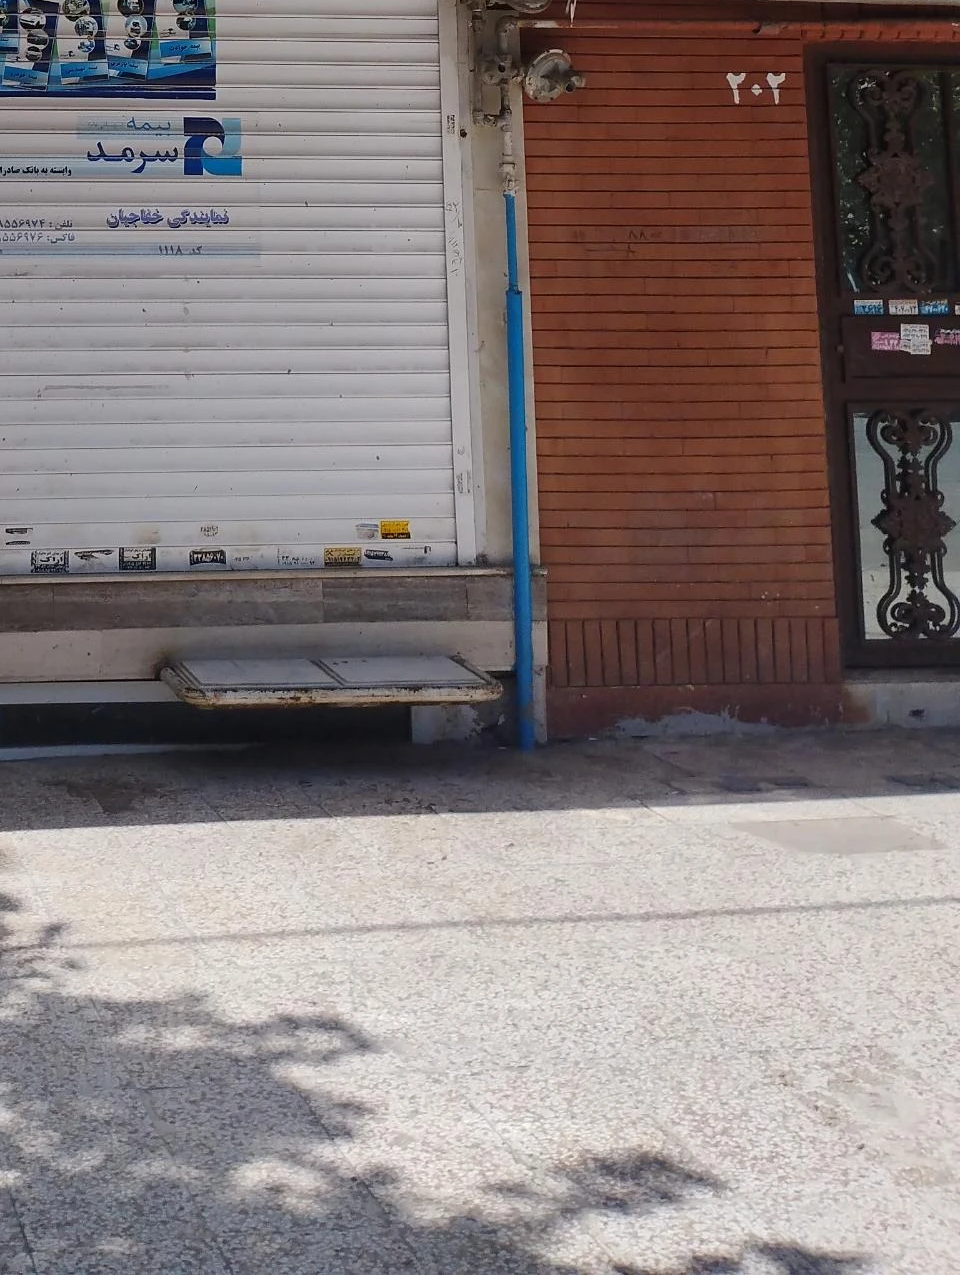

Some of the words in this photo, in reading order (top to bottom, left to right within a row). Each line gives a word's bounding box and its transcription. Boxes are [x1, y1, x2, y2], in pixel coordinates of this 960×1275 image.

[726, 73, 786, 105] ۲۰۲
[126, 117, 171, 136] بیمه
[87, 142, 179, 173] سرمد
[22, 164, 40, 176] بانک
[50, 164, 72, 176] وابسته
[106, 208, 164, 229] خفاجیان
[166, 208, 230, 229] نمایندگی
[158, 244, 183, 256] ۱۱۱۸
